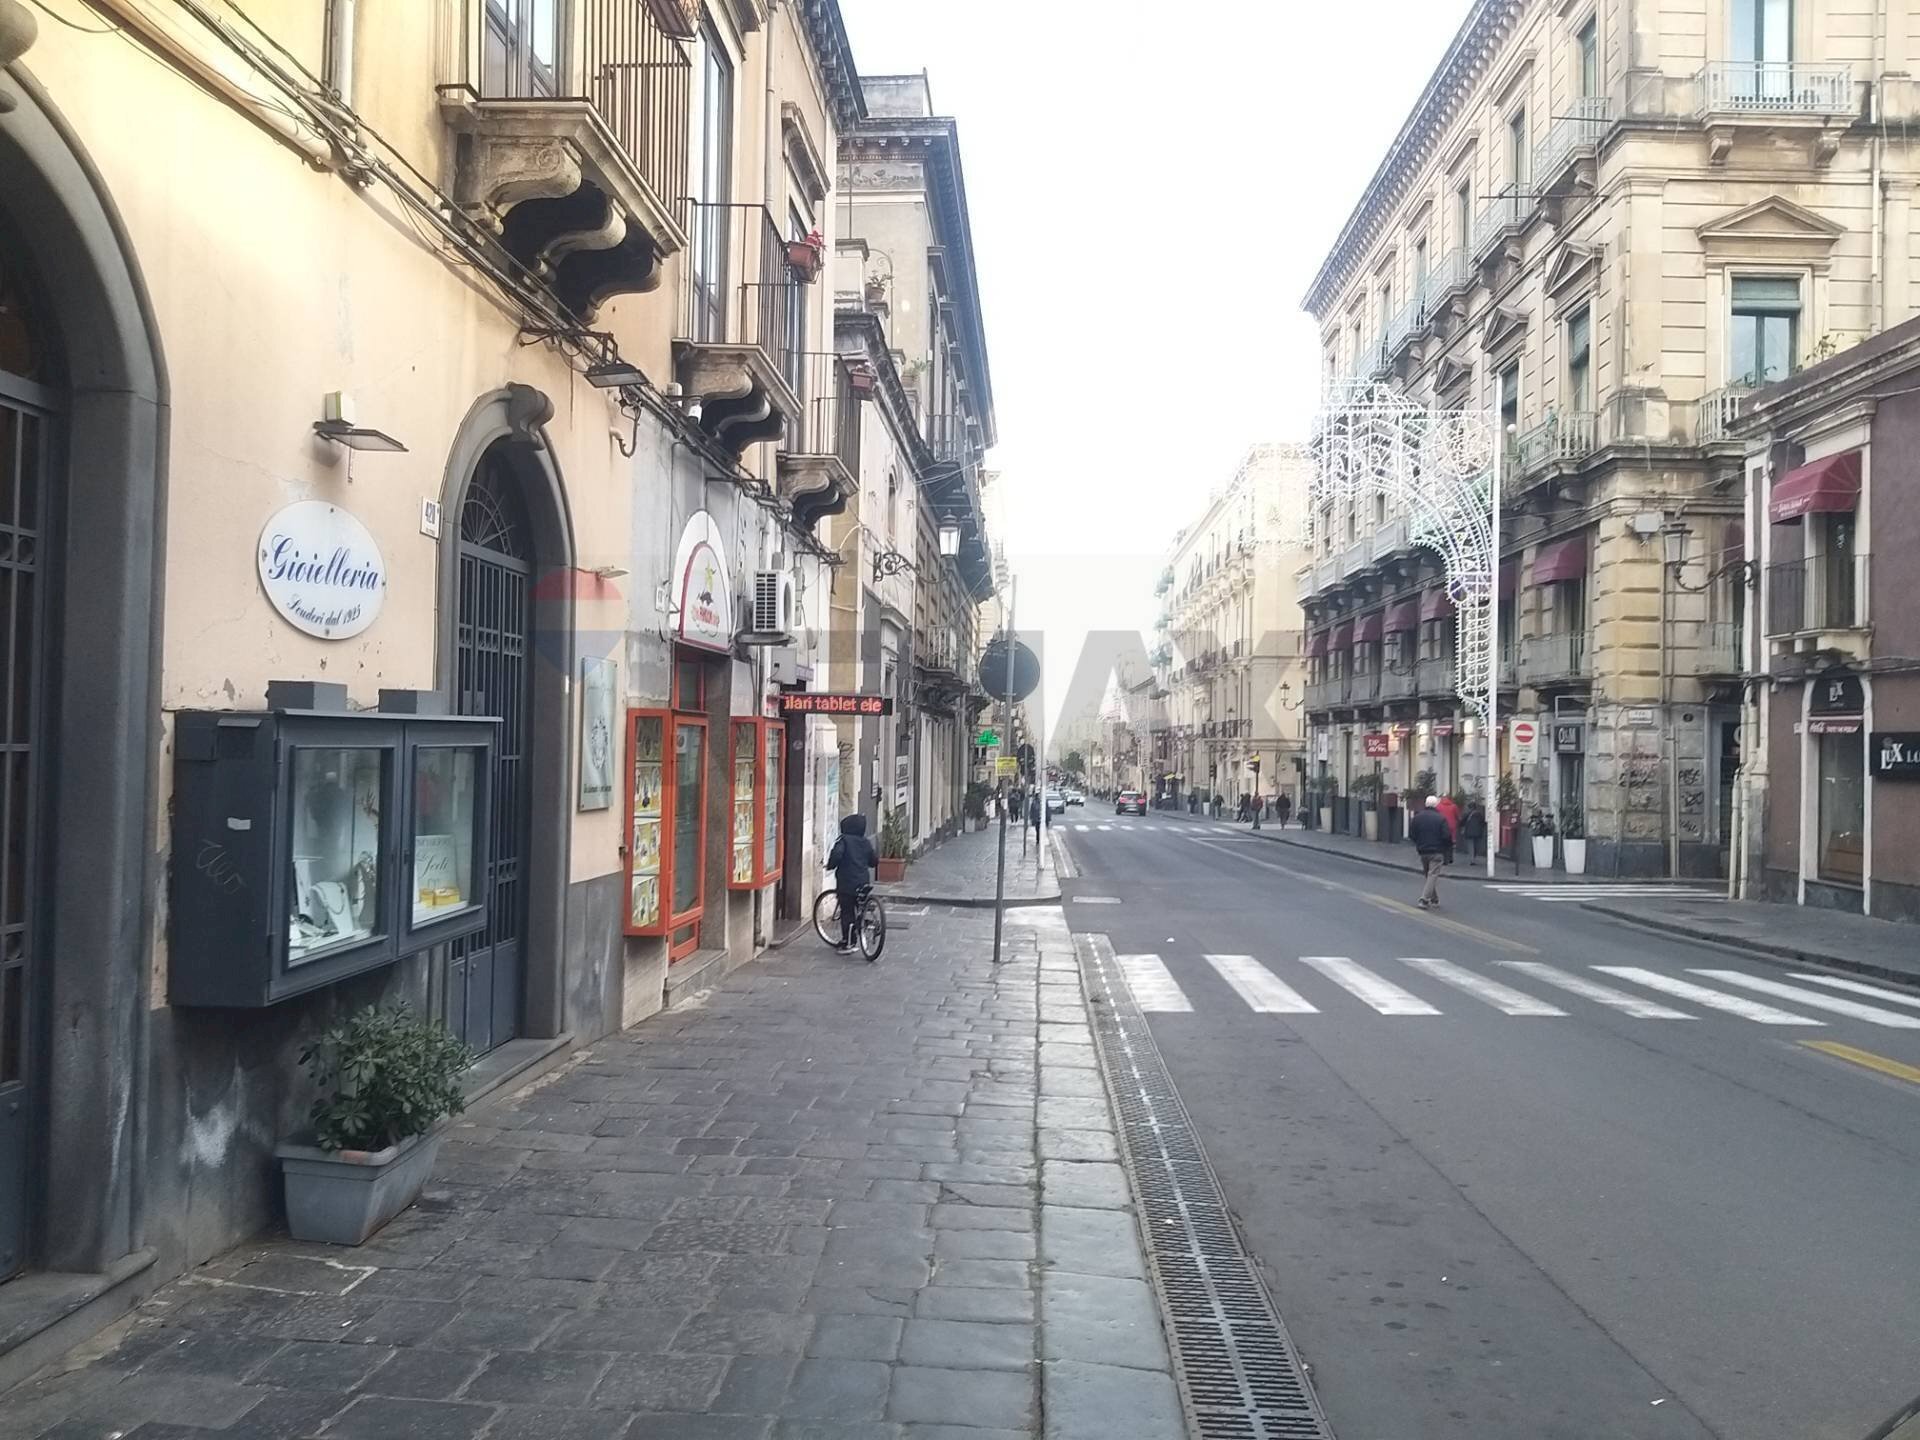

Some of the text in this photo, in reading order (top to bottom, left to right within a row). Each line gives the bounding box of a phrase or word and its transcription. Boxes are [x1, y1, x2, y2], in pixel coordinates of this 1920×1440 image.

[268, 534, 379, 590] Gioielleria
[325, 609, 343, 626] dal
[815, 696, 857, 711] tablet
